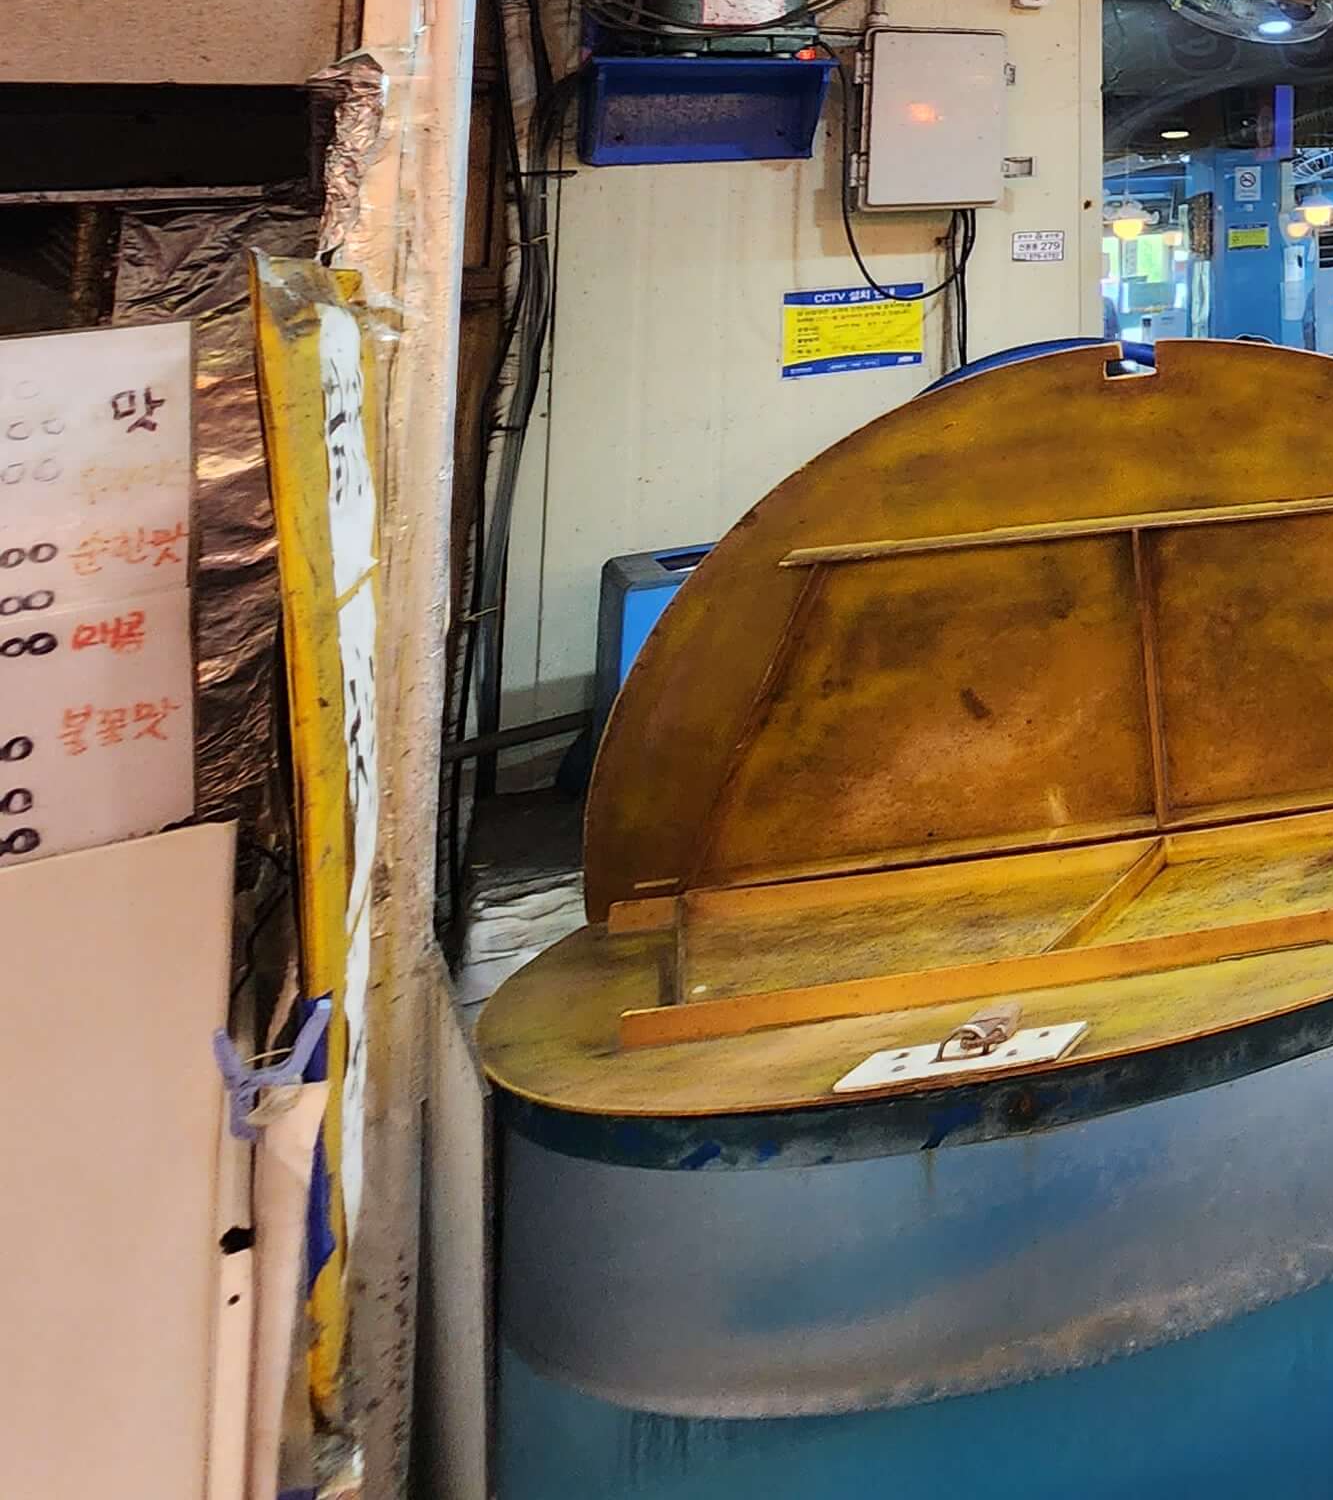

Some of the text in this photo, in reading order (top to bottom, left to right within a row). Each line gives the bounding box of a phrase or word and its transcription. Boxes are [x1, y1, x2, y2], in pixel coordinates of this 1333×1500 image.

[1040, 241, 1060, 251] 279
[813, 293, 846, 304] CCTV
[111, 385, 166, 434] 맛
